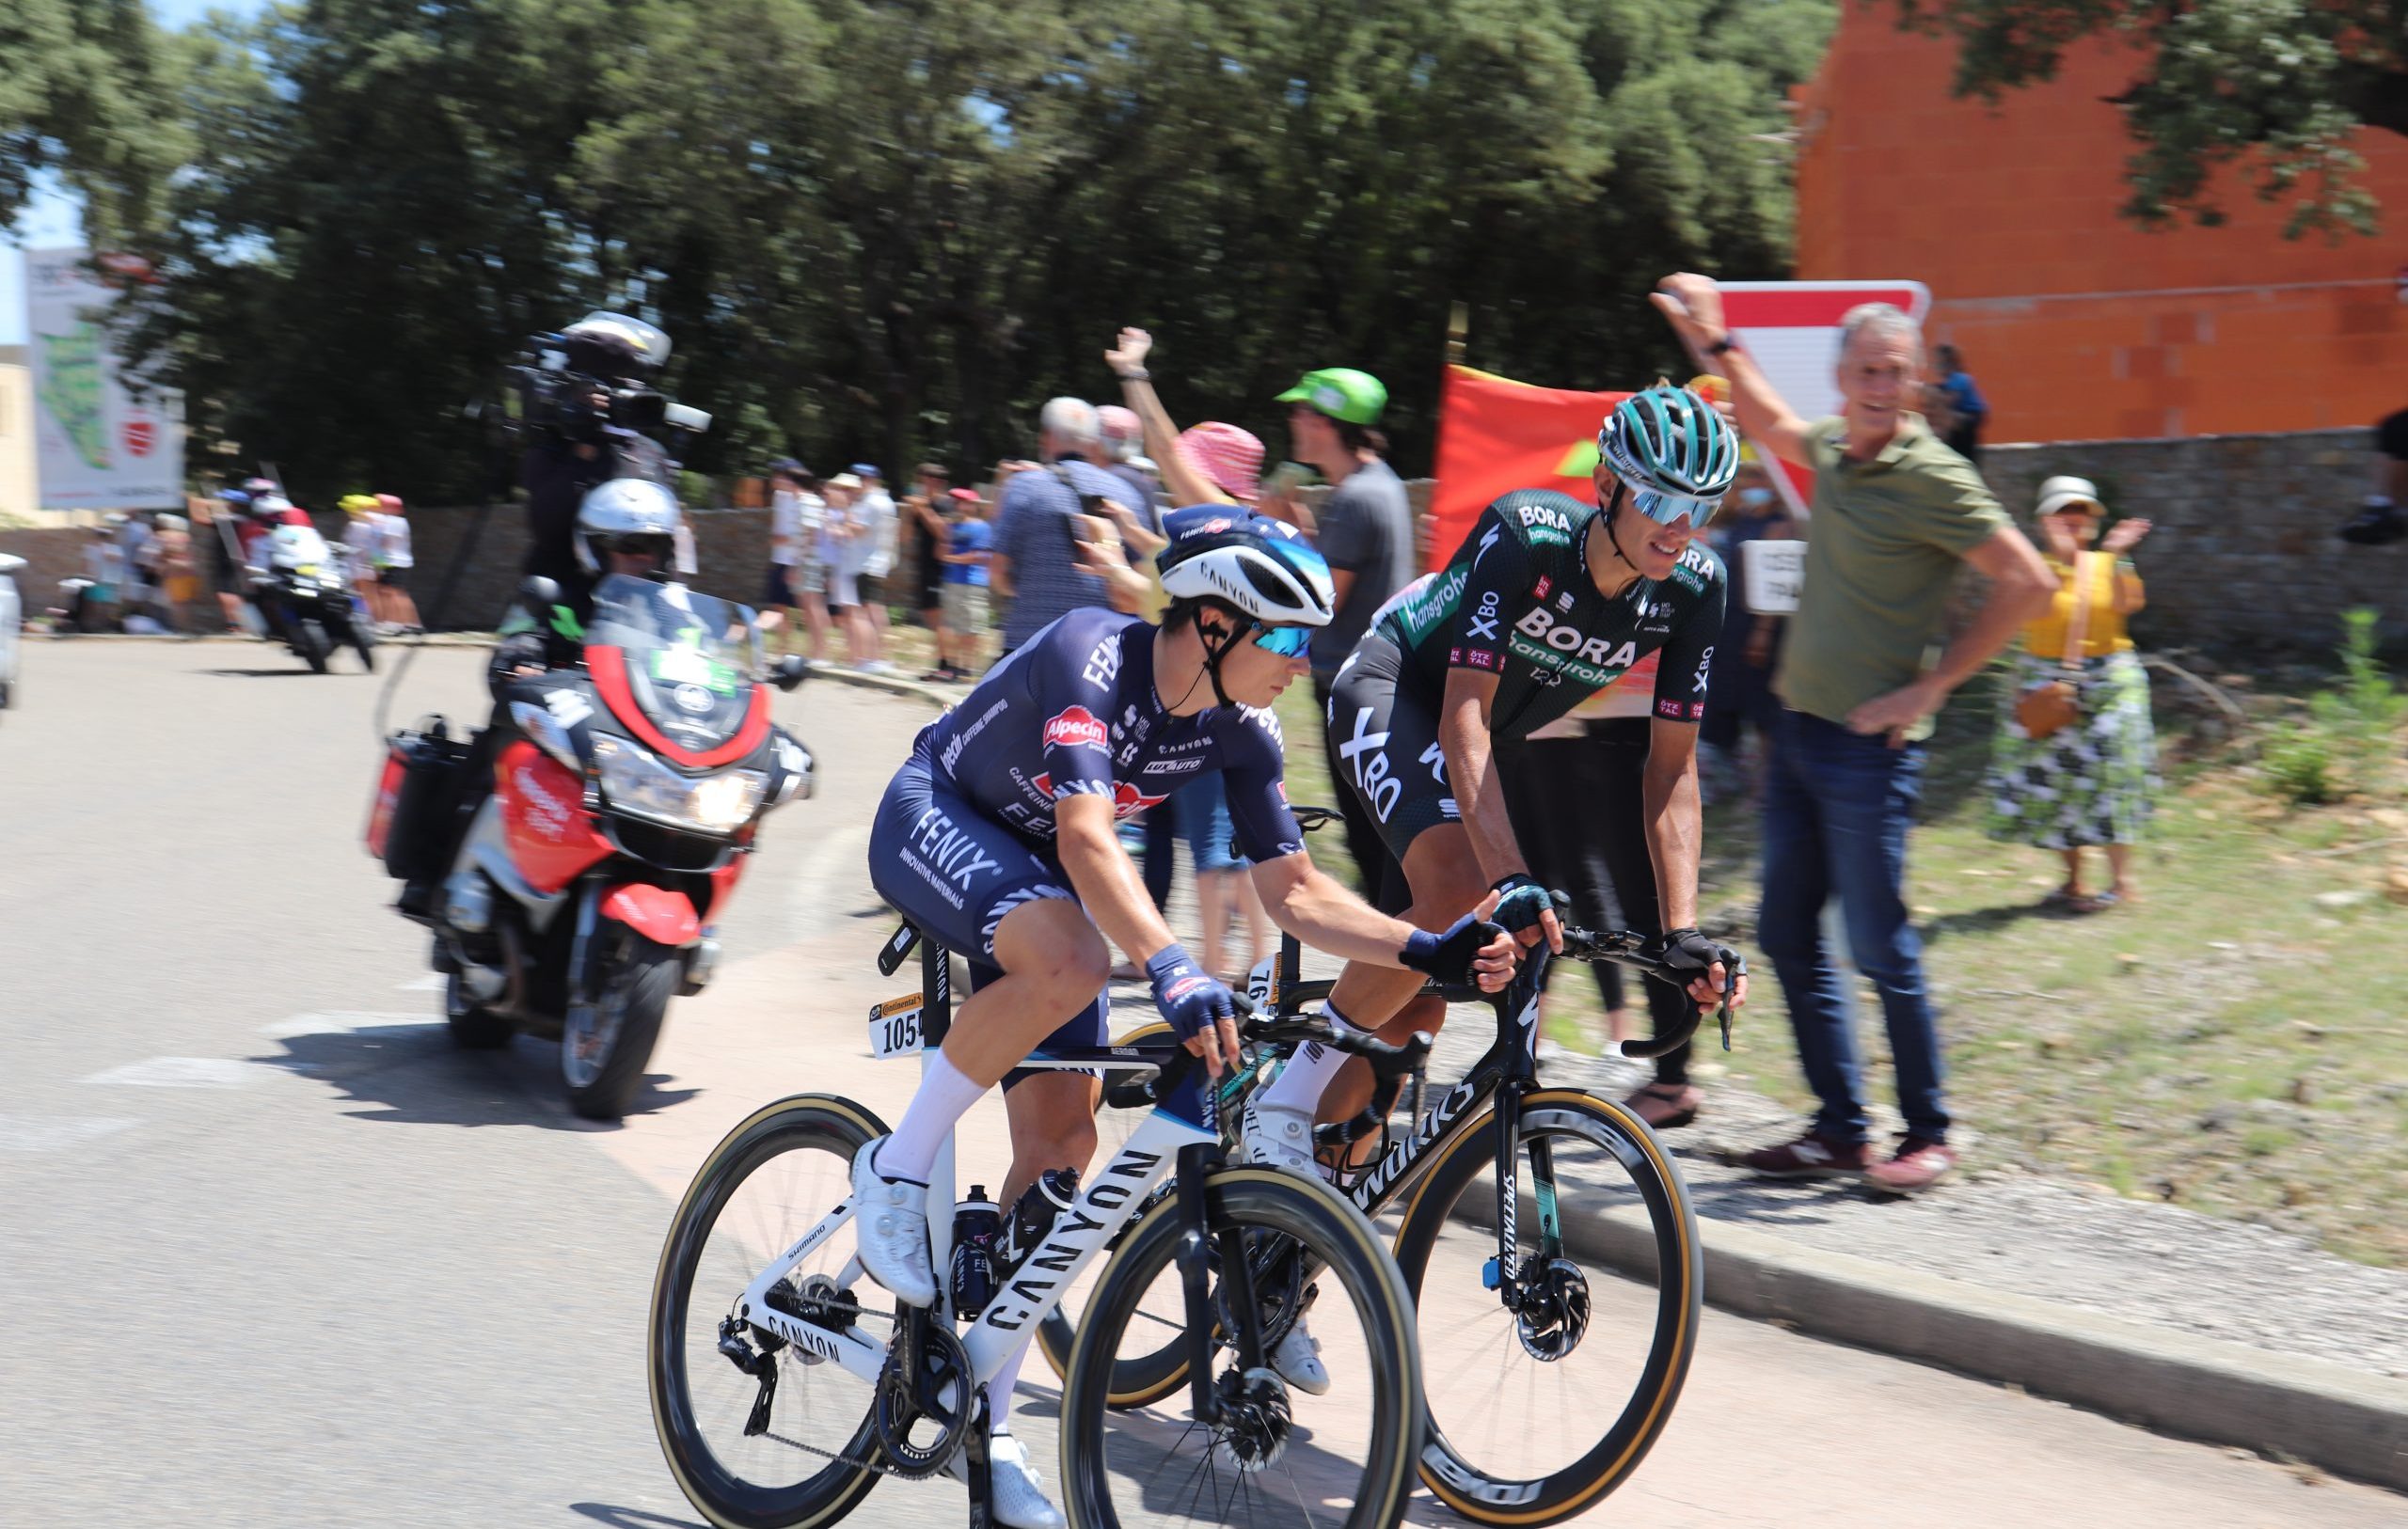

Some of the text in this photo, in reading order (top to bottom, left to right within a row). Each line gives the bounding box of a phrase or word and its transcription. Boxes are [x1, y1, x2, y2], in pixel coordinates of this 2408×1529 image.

[1518, 505, 1572, 533] BORA
[1200, 561, 1259, 613] CANYON
[1465, 591, 1499, 640] XBO
[1515, 606, 1637, 668] BORA
[1470, 651, 1490, 660] ÖTZ
[1470, 657, 1488, 667] TAL
[1692, 645, 1714, 694] XBO
[962, 717, 985, 746] CAFFEINE
[983, 698, 1008, 726] SHAMPOO
[1046, 718, 1102, 740] Alpecin
[1660, 706, 1678, 715] TAL
[1158, 735, 1212, 755] CANYON
[1339, 707, 1402, 824] XBO
[1009, 766, 1055, 812] CAFFEINE
[910, 806, 999, 891] FENIX
[899, 846, 965, 911] INNOVATIVE MATERIALS
[883, 997, 916, 1016] Continental
[1249, 970, 1270, 1001] 76
[883, 1014, 916, 1054] 105
[787, 1223, 826, 1261] SHIMANO
[986, 1149, 1162, 1332] CANYON
[1503, 1174, 1516, 1280] SPECIALIZED
[768, 1315, 841, 1363] CANYON
